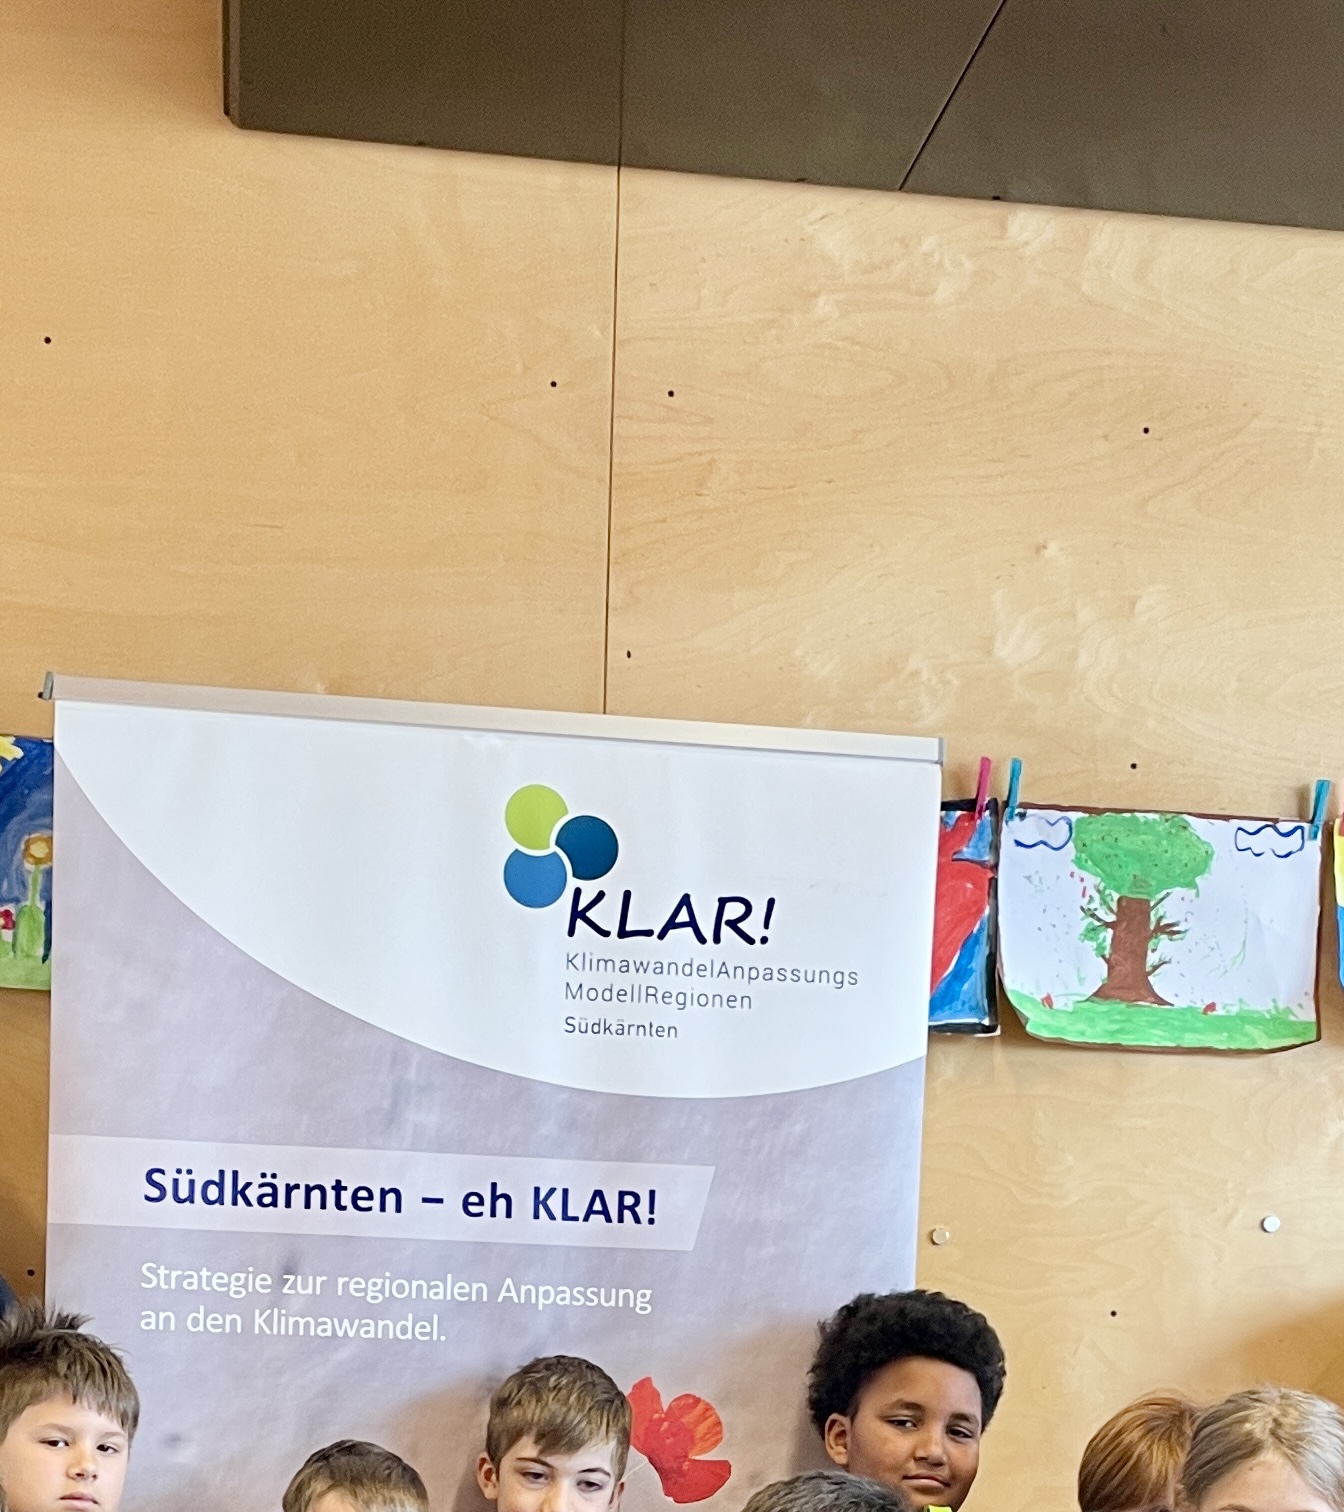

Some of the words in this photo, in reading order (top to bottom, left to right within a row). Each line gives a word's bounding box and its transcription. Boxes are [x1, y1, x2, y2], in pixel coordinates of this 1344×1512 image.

[566, 886, 776, 946] KLAR!
[565, 951, 859, 989] KlimawandelAnpassungs
[564, 982, 752, 1011] ModellRegionen
[563, 1015, 679, 1039] Südkärnten
[143, 1166, 403, 1214] Südkärnten
[461, 1182, 513, 1219] eh
[532, 1185, 658, 1225] KLAR!
[140, 1262, 272, 1298] Strategie
[282, 1273, 325, 1296] zur
[336, 1273, 488, 1304] regionalen
[497, 1276, 653, 1315] Anpassung
[139, 1309, 176, 1332] an
[186, 1307, 243, 1334] den
[253, 1308, 447, 1343] Klimawandel.
